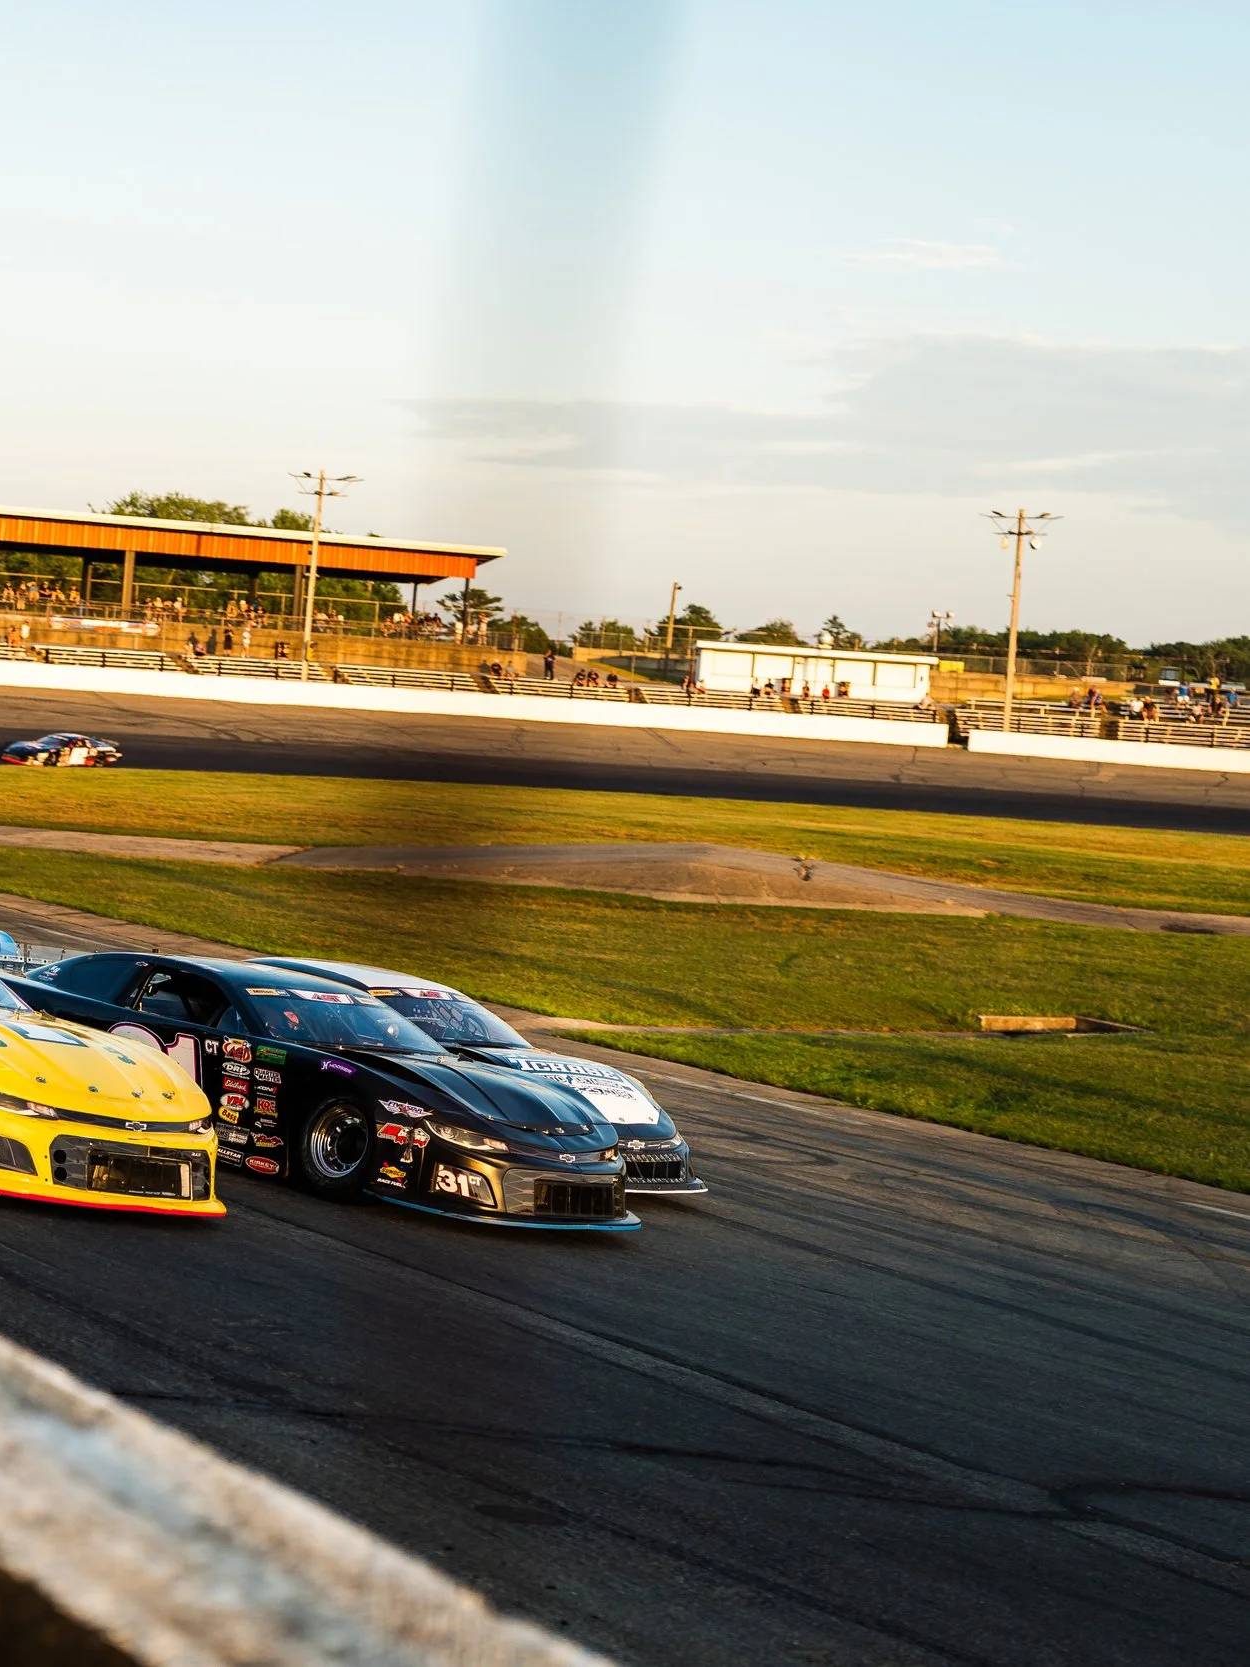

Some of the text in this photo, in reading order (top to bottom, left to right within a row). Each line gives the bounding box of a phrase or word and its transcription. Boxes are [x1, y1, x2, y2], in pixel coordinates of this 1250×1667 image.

[205, 1039, 219, 1055] CT
[226, 1064, 247, 1073] DRP
[225, 1080, 247, 1091] Edelbrock
[250, 1158, 273, 1168] KIRKEY
[381, 1167, 405, 1177] SUNOCO
[436, 1169, 482, 1197] 31 CT
